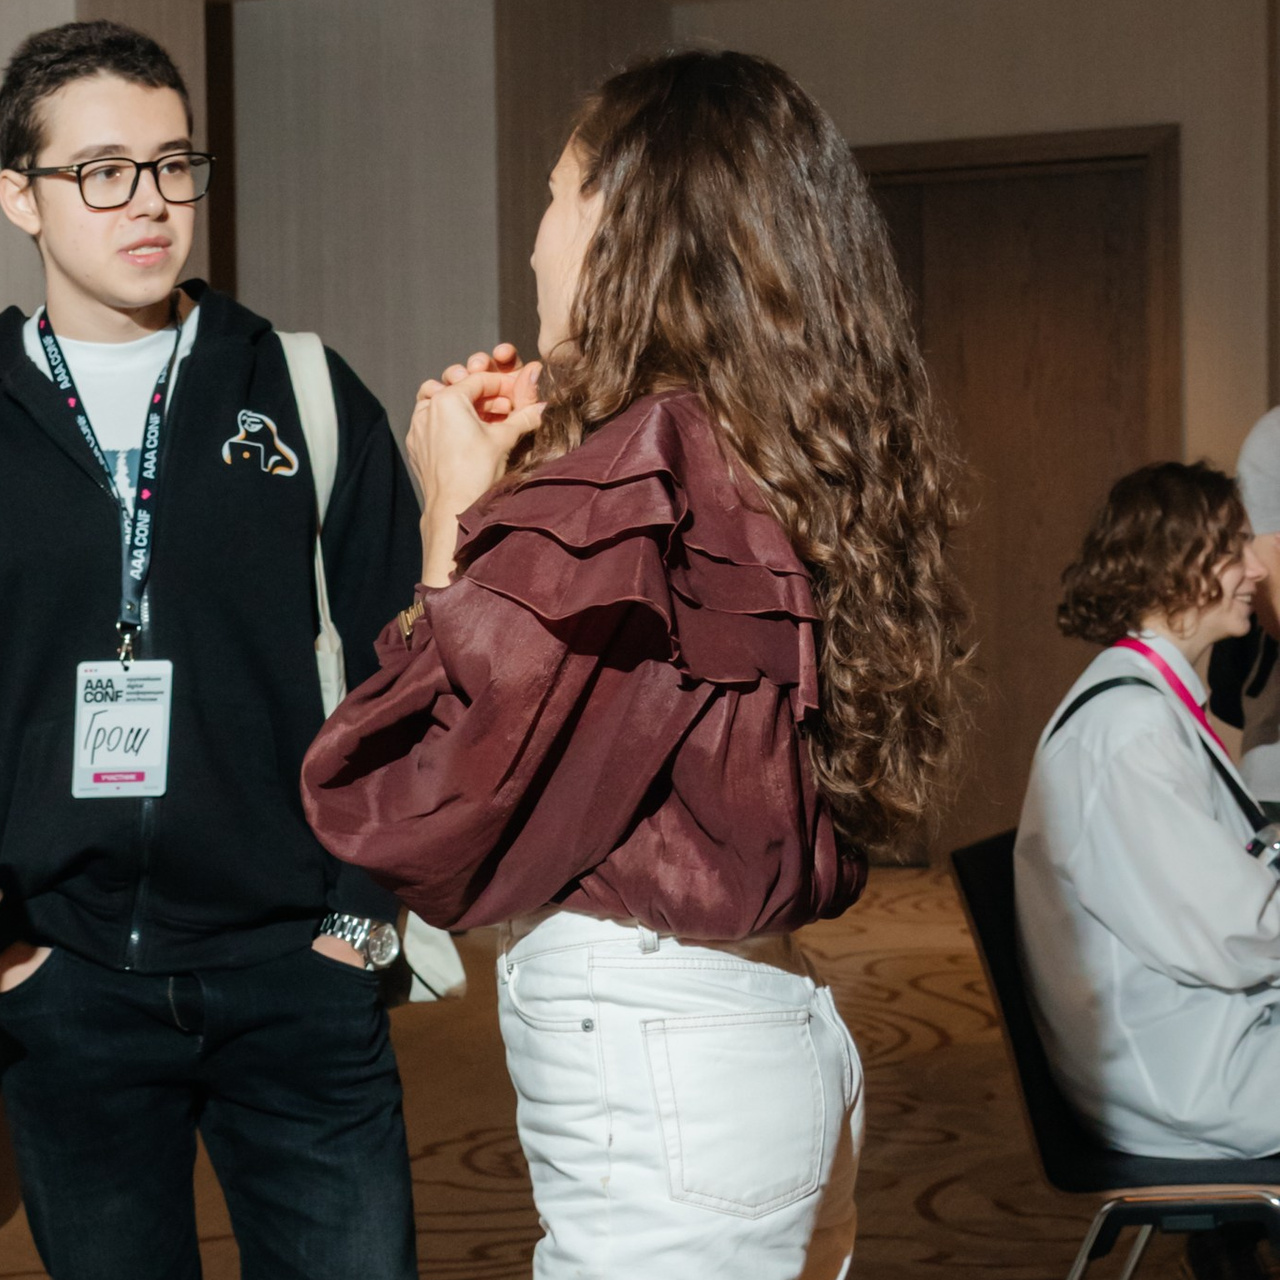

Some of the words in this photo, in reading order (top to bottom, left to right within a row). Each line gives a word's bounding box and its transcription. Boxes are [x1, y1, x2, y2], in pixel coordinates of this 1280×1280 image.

[42, 335, 61, 366] CONF
[54, 364, 72, 391] AAA
[145, 413, 161, 449] CONF
[142, 449, 158, 480] AAA
[134, 509, 151, 547] CONF
[130, 548, 147, 580] AAA
[84, 678, 115, 691] AAA
[84, 690, 124, 704] CONF
